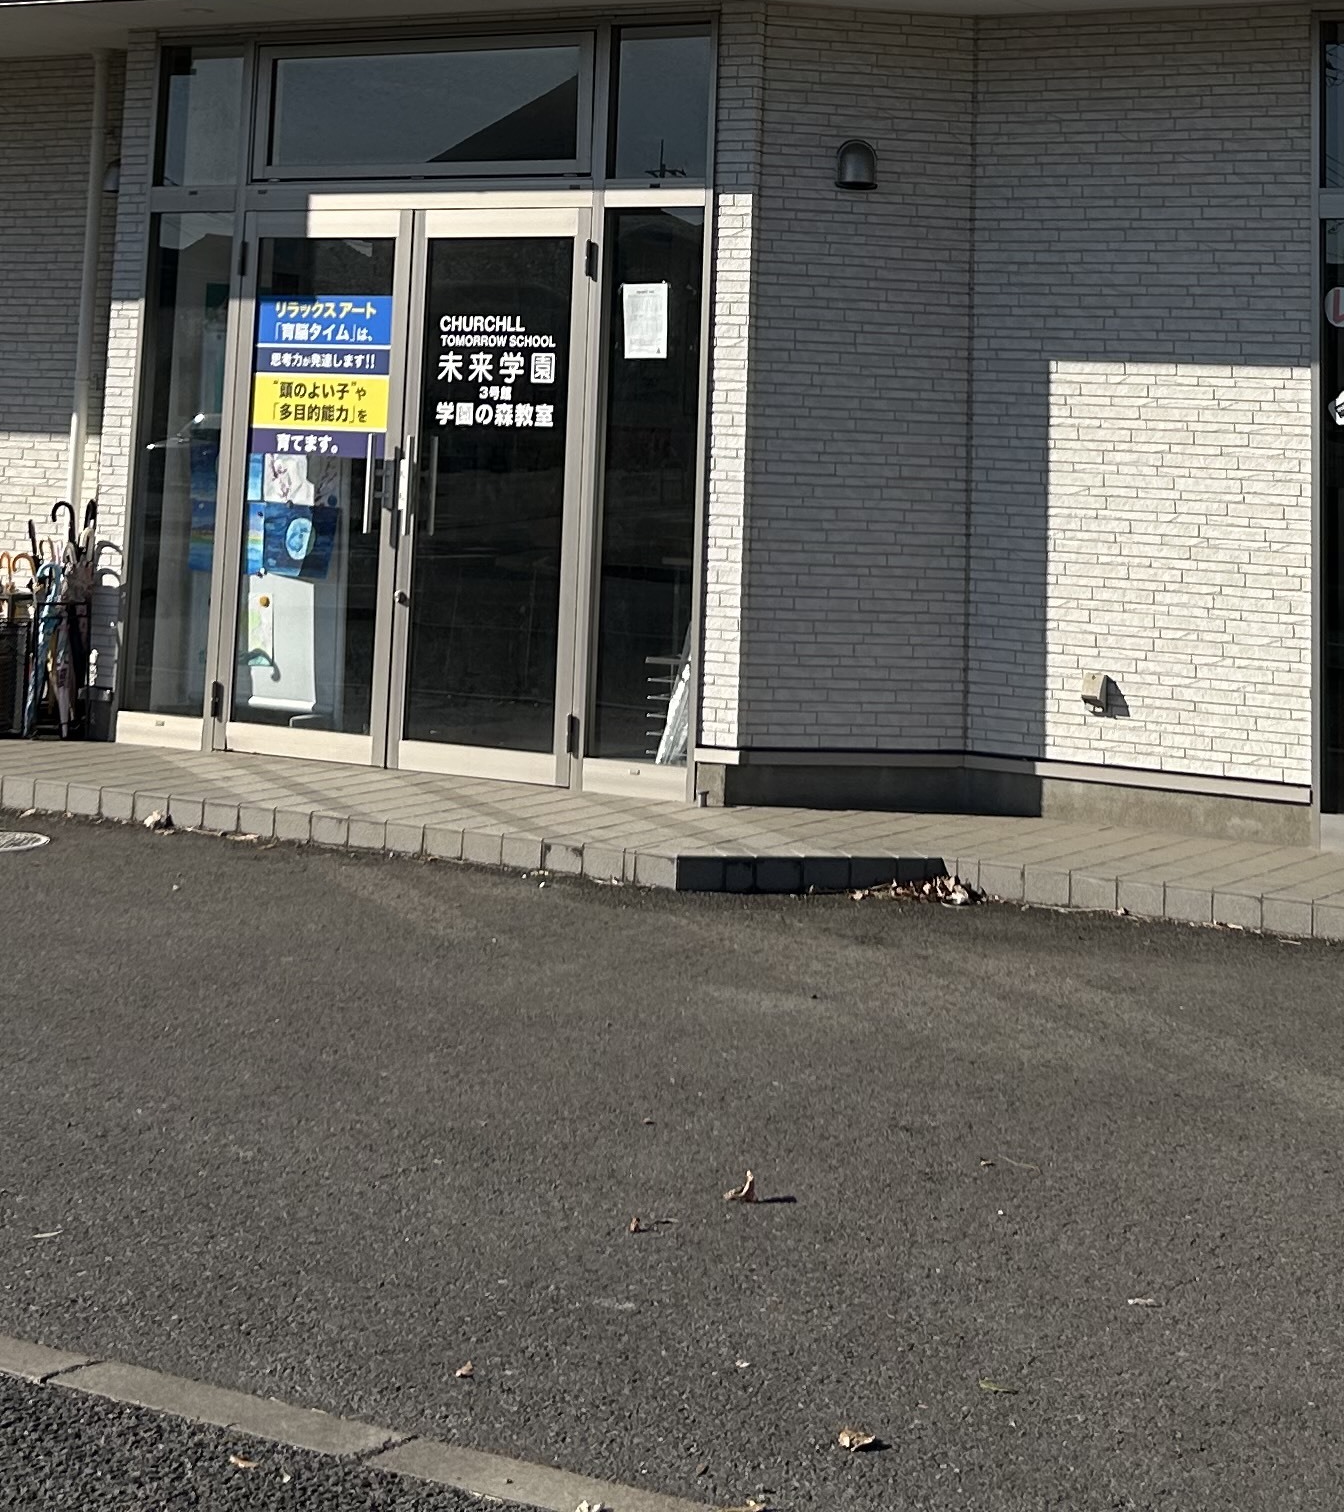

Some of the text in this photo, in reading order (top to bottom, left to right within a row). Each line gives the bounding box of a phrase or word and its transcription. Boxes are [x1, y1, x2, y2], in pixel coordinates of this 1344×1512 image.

[439, 315, 526, 332] CHURCHLL
[440, 334, 556, 348] TOMORROW SCHOOL
[437, 350, 556, 384] 未来学園
[435, 401, 554, 428] 学園の森教室
